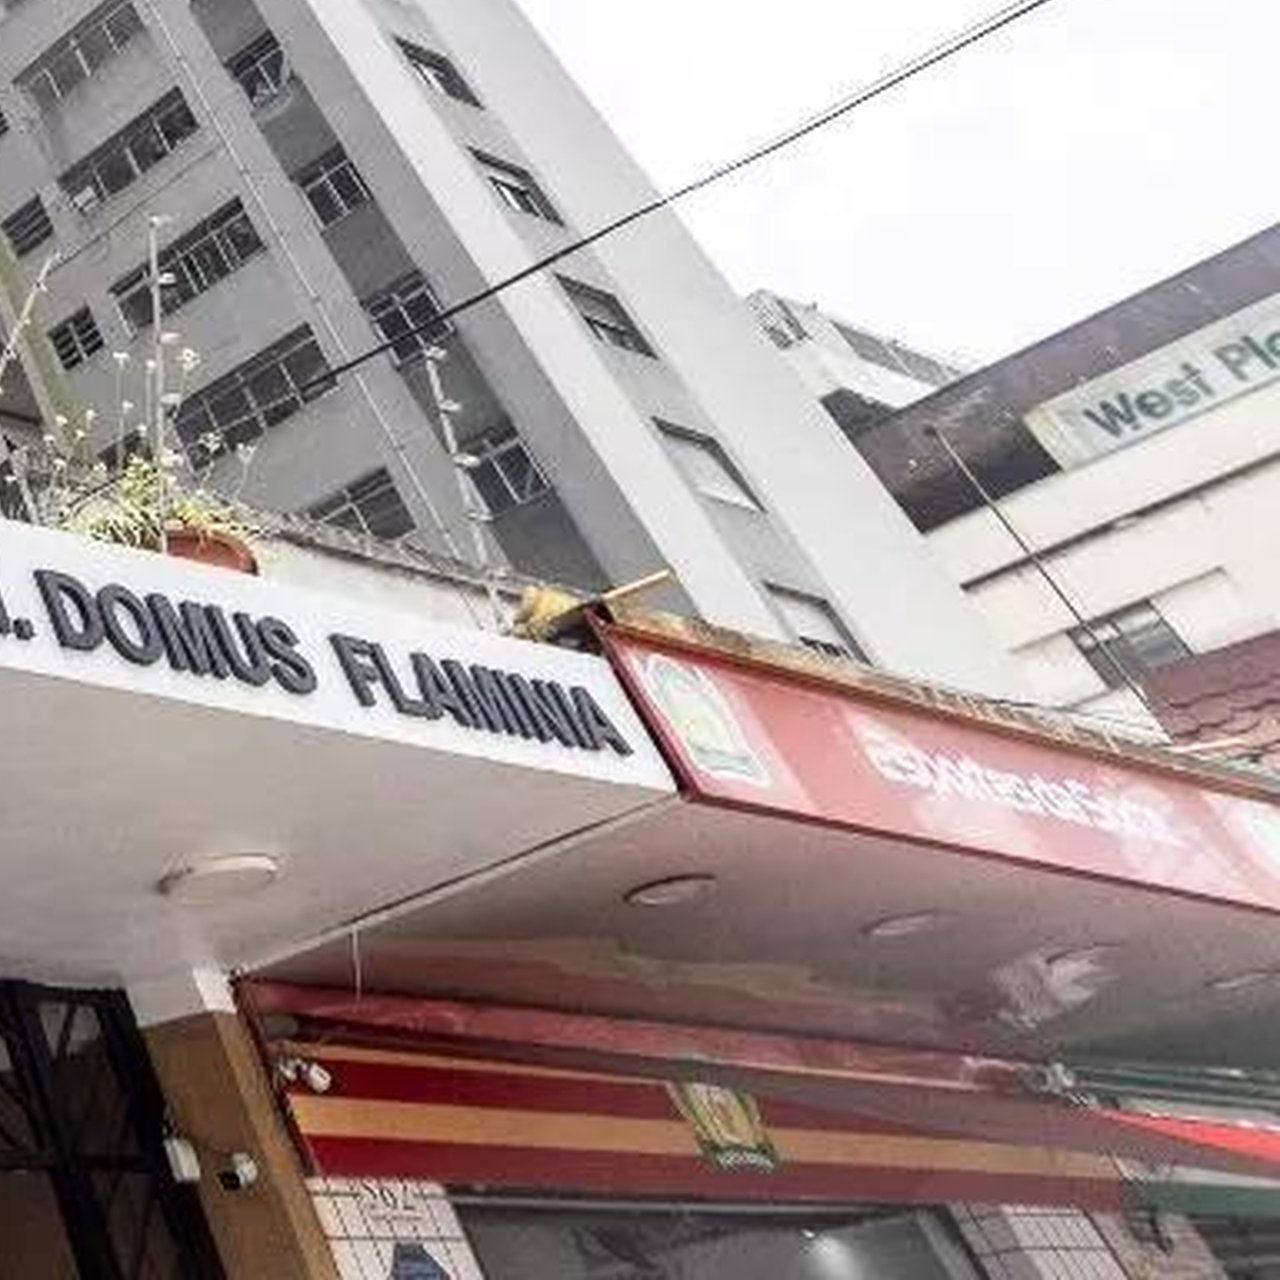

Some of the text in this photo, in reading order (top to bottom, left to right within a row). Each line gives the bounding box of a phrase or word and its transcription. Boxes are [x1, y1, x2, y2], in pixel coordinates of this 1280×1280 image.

[1082, 361, 1216, 438] West
[34, 567, 318, 696] DOMUS
[328, 631, 635, 758] FLAMINIA
